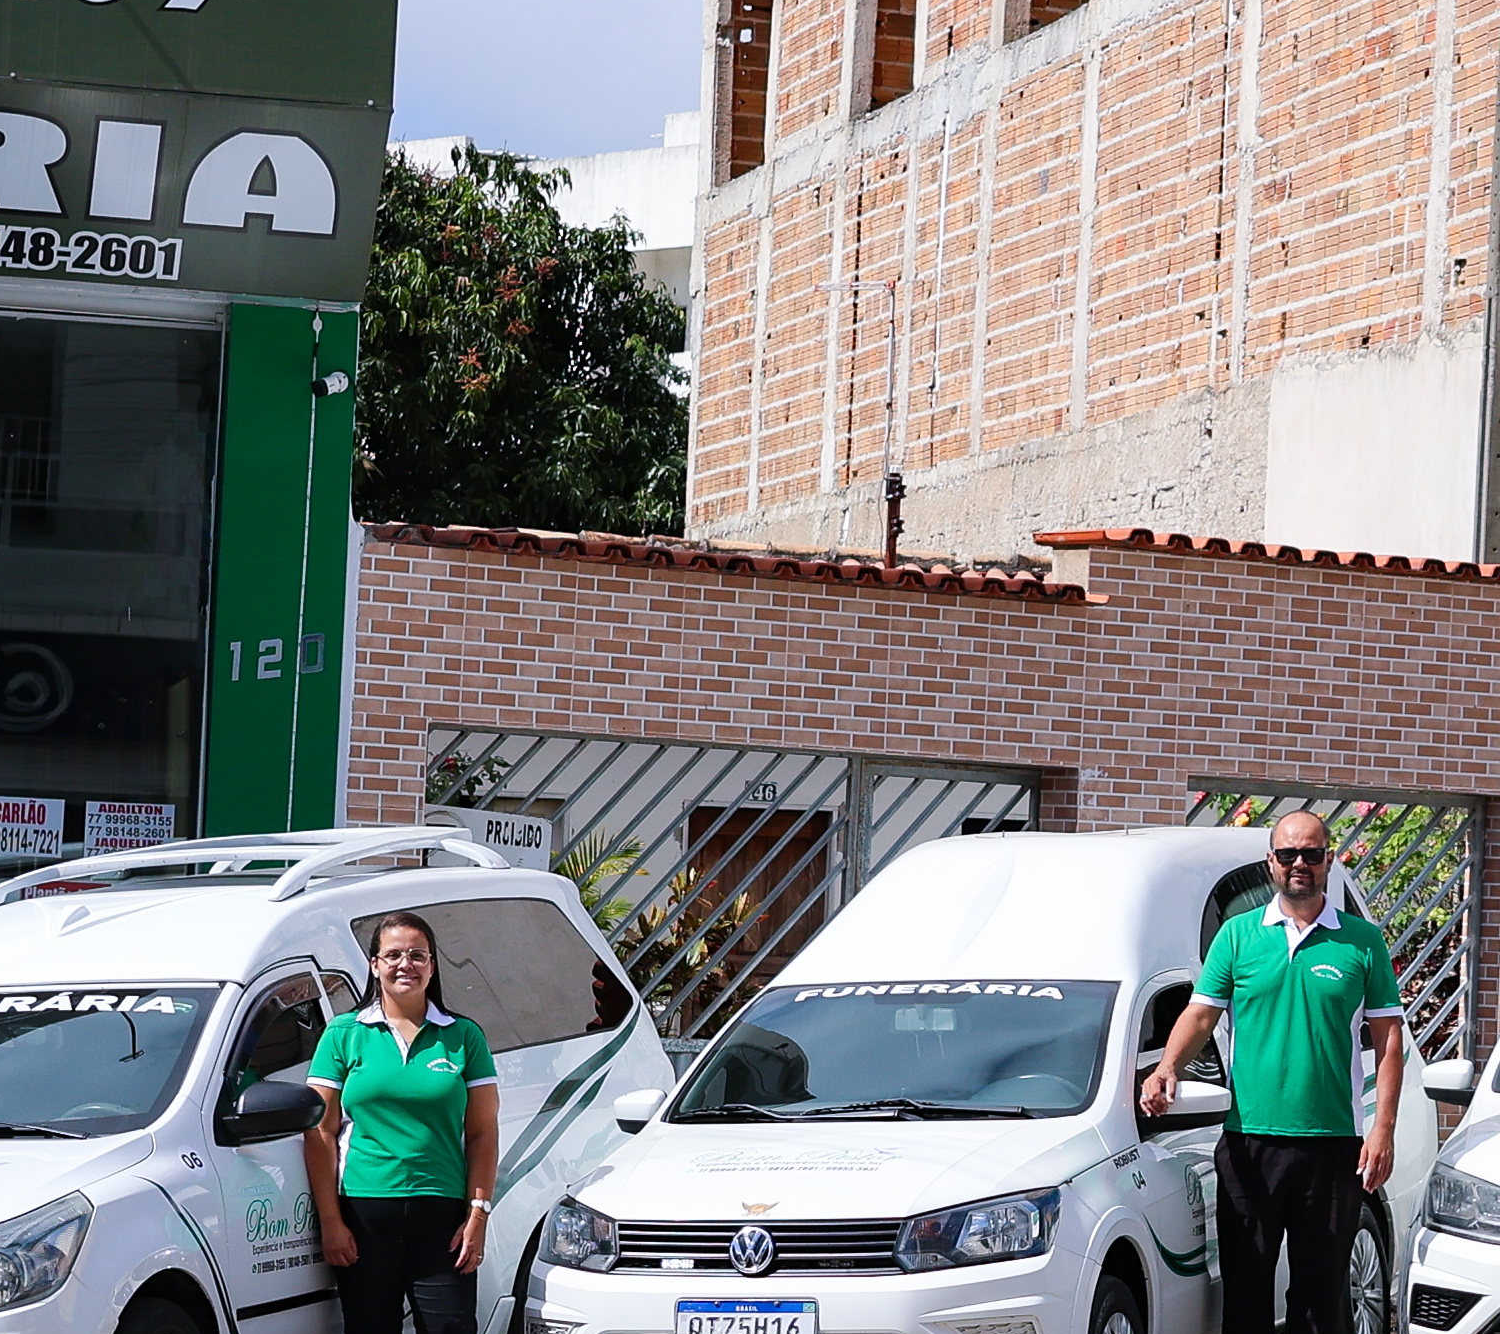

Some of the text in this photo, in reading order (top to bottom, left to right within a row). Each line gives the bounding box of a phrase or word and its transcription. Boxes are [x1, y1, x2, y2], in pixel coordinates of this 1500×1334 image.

[228, 632, 326, 682] 120
[98, 803, 164, 815] ADAILTON
[88, 813, 173, 827] 77 99968-3155
[88, 825, 172, 839] 77 98148-2601
[24, 886, 71, 899] Plantã
[793, 980, 1065, 1003] FUNERÁRIA
[181, 1151, 204, 1170] 06
[1112, 1148, 1141, 1170] ROBUST
[1131, 1170, 1147, 1190] 04
[246, 1198, 289, 1242] Bom
